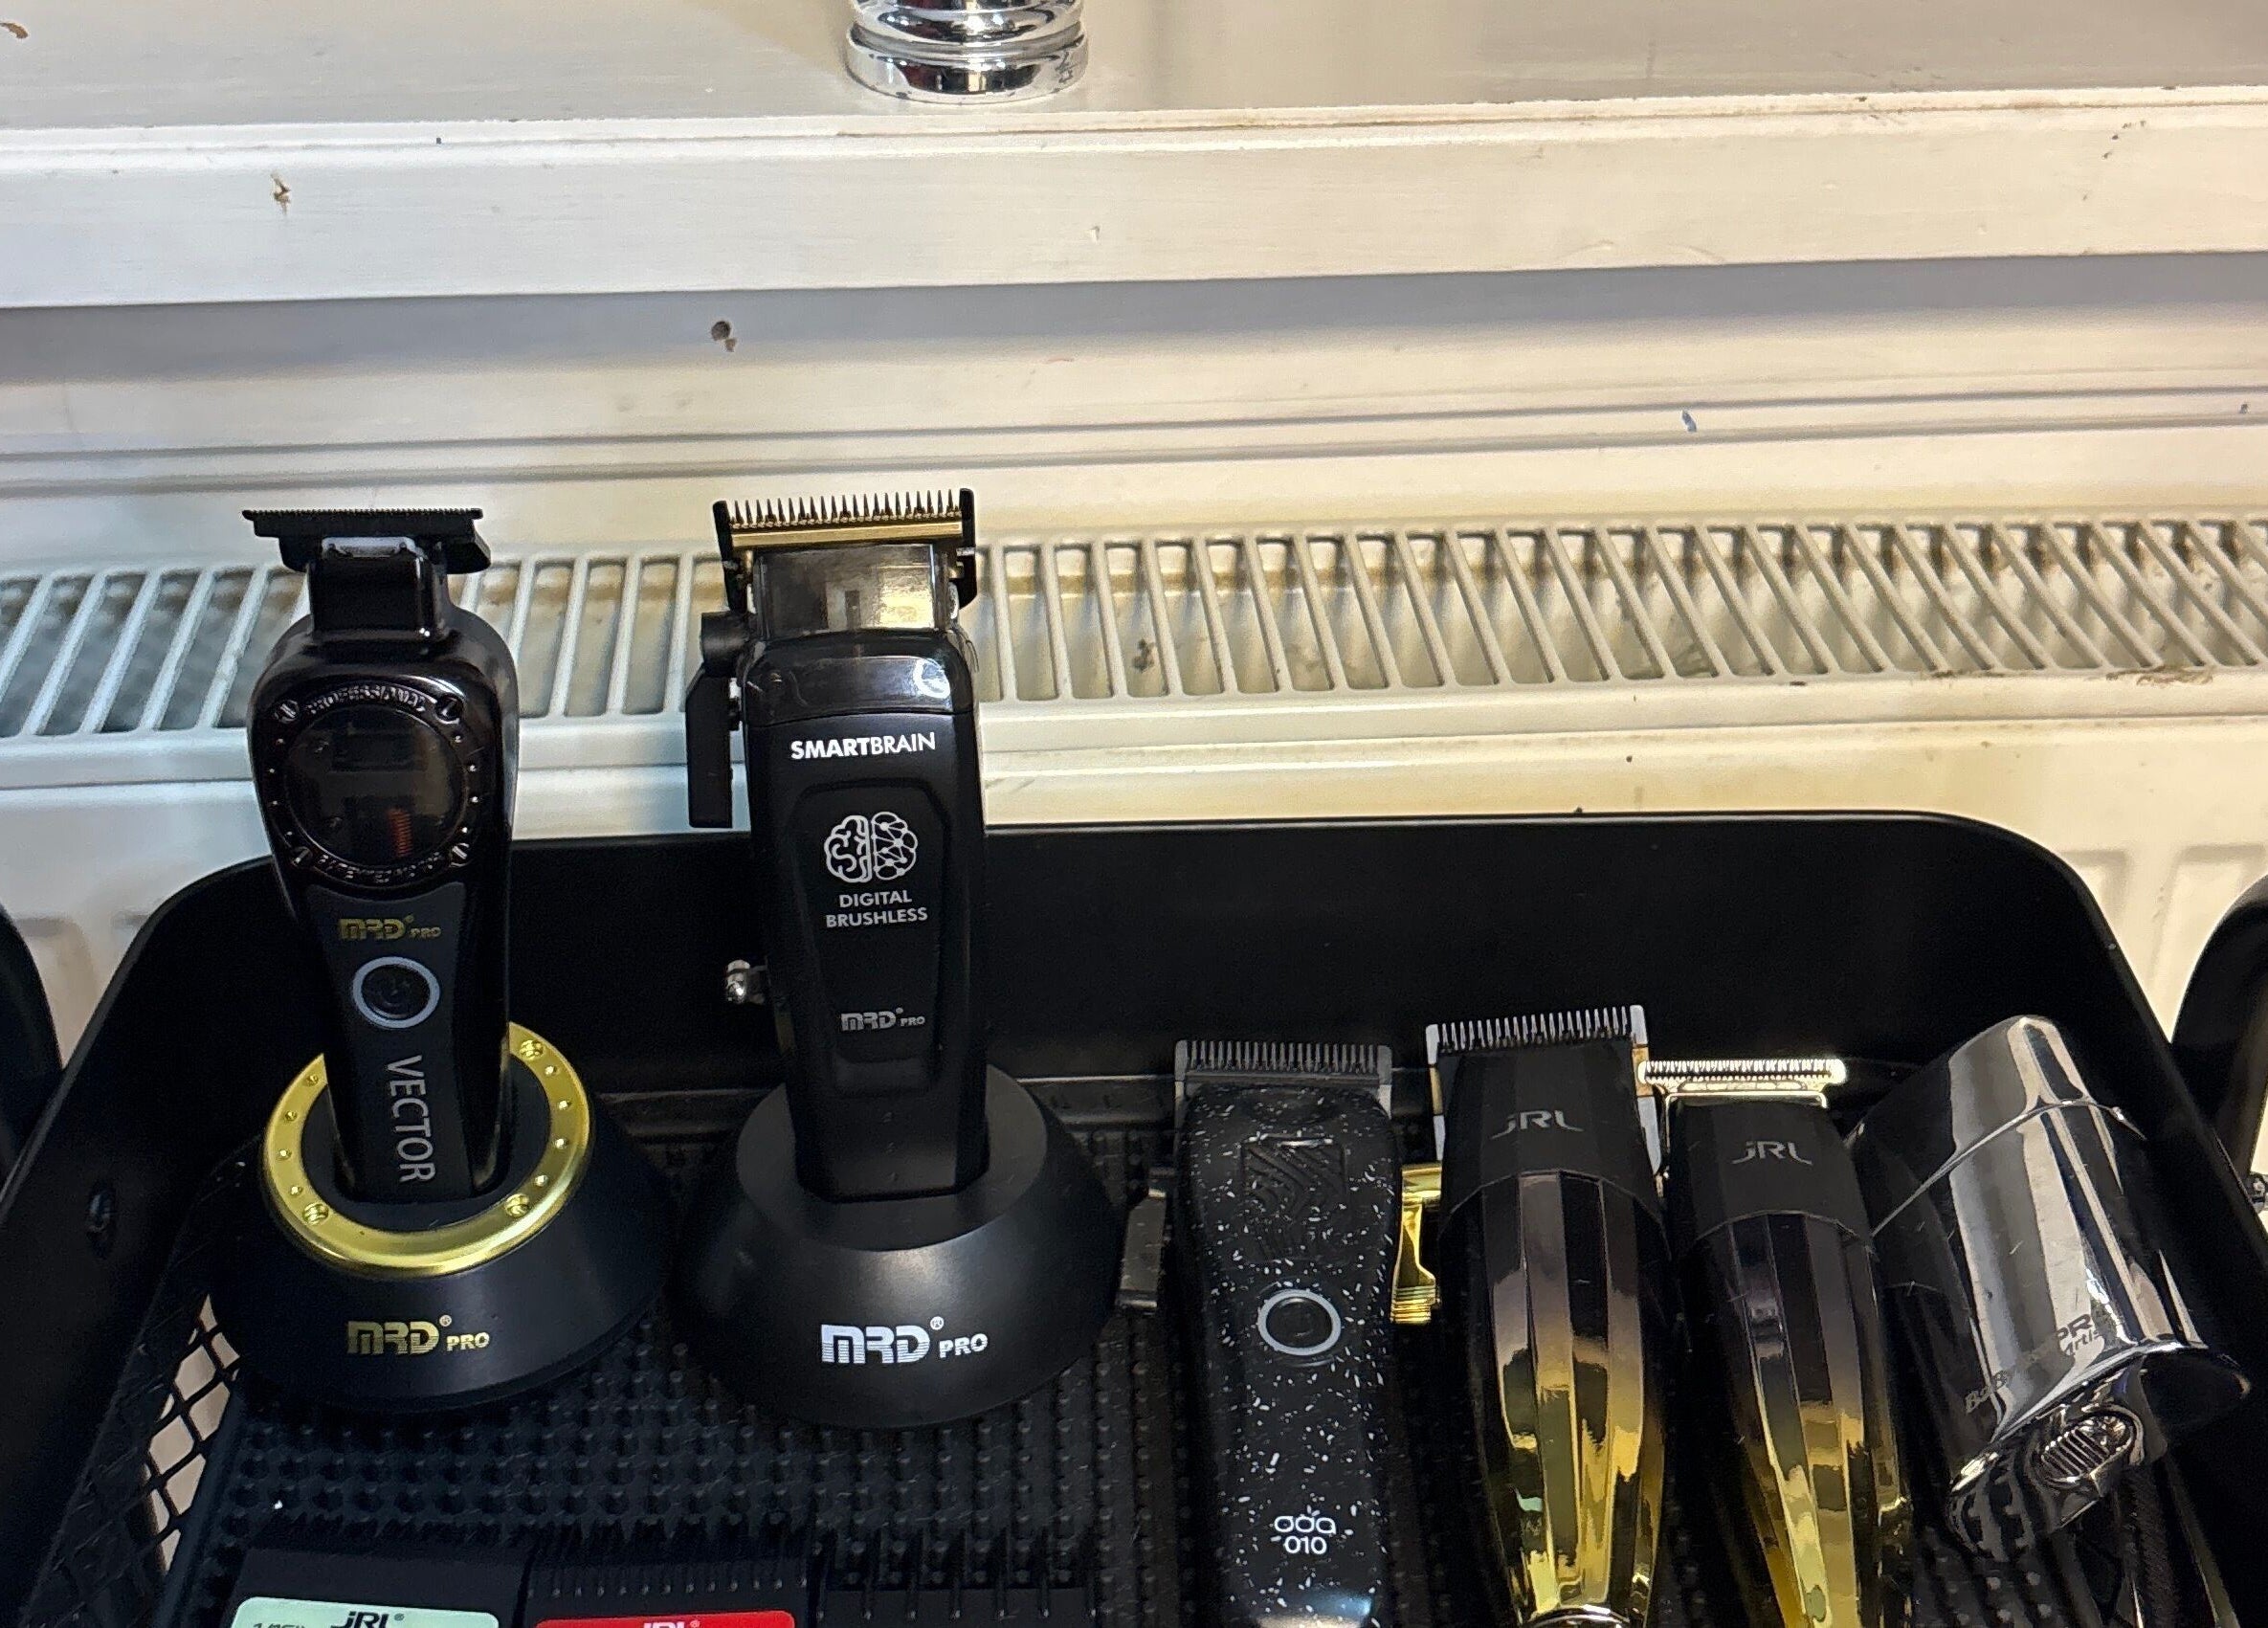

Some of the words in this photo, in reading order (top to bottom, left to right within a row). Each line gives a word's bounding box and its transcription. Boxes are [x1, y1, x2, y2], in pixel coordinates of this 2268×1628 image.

[790, 731, 936, 761] SMARTBRAIN
[838, 889, 913, 908] DIGITAL
[825, 906, 929, 928] BRUSHLESS
[410, 926, 442, 939] PRO
[900, 1015, 925, 1027] PRO
[385, 1054, 436, 1184] VECTOR
[446, 1331, 491, 1352] PRO
[938, 1332, 989, 1359] PRO
[1283, 1535, 1328, 1555] 010
